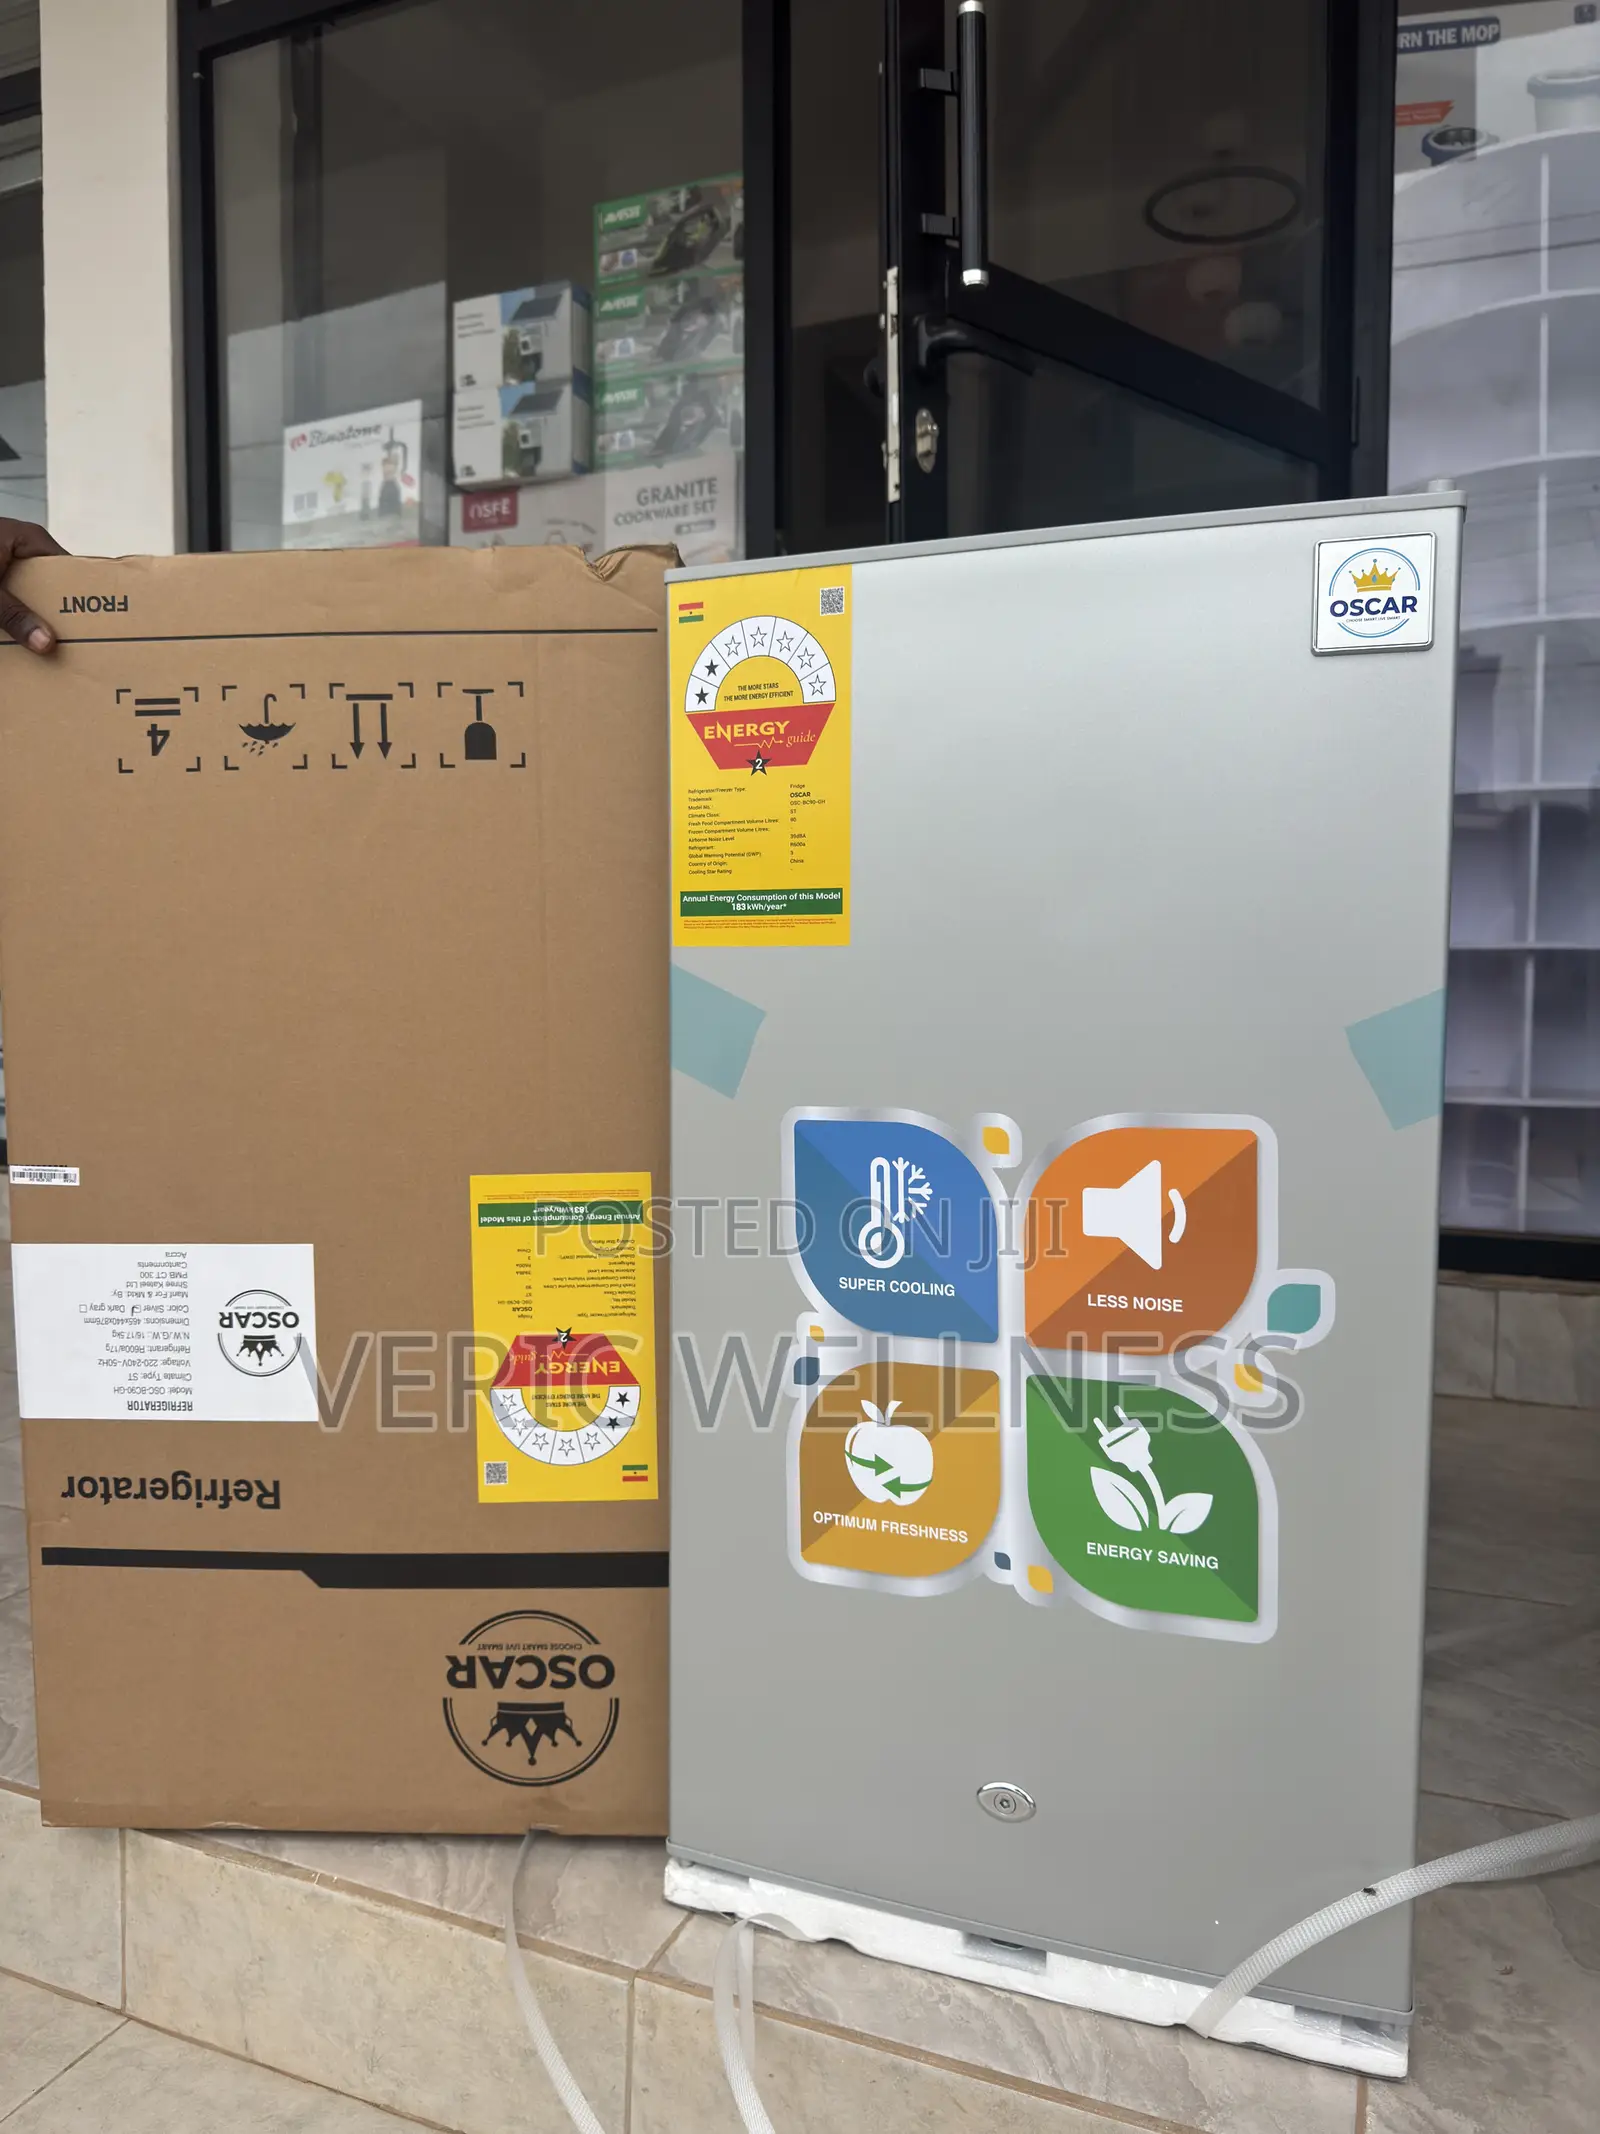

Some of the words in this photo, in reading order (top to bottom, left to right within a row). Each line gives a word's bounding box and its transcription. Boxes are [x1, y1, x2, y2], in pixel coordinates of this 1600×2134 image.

[1426, 28, 1457, 46] THE
[1461, 24, 1499, 43] MOP
[636, 477, 718, 507] GRANITE
[613, 503, 691, 527] COOKWARE
[693, 498, 717, 516] SET
[60, 594, 128, 613] FRONT
[1330, 596, 1418, 618] OSCAR
[764, 682, 779, 690] STARS
[748, 692, 768, 700] ENERGY
[704, 721, 790, 743] ENERGY
[147, 723, 170, 757] 4
[786, 729, 816, 748] guide
[756, 758, 762, 770] 2
[710, 894, 734, 903] Energy
[736, 893, 787, 902] Consumption
[816, 892, 840, 900] Model
[533, 1213, 584, 1222] Consumption
[138, 1261, 187, 1269] Cantonments
[838, 1276, 887, 1293] SUPER
[889, 1278, 956, 1296] COOLING
[89, 1303, 105, 1312] gray
[107, 1305, 125, 1313] Dark
[143, 1305, 164, 1313] Silver
[167, 1305, 189, 1313] Color:
[1086, 1293, 1130, 1310] LESS
[1132, 1295, 1184, 1314] NOISE
[84, 1317, 141, 1325] 465x440x876mm
[144, 1318, 190, 1326] Dimensions:
[219, 1312, 299, 1329] OSCAR
[560, 1333, 568, 1342] 2
[106, 1343, 145, 1353] R600a/17g
[147, 1344, 190, 1354] Refrigerant:
[160, 1358, 191, 1367] Voltage:
[510, 1352, 538, 1366] guide
[534, 1357, 620, 1376] ENERGY
[128, 1372, 139, 1381] ST
[140, 1371, 162, 1381] Type:
[163, 1372, 192, 1382] Climate
[113, 1386, 165, 1394] OSC-BC90-GH
[168, 1387, 192, 1395] Model:
[127, 1401, 193, 1412] REFRIGERATOR
[62, 1470, 280, 1510] Refrigerator
[813, 1510, 878, 1532] OPTIMUM
[881, 1518, 968, 1544] FRESHNESS
[1086, 1541, 1152, 1563] ENERGY
[1157, 1549, 1219, 1570] SAVING
[445, 1654, 615, 1690] OSCAR
